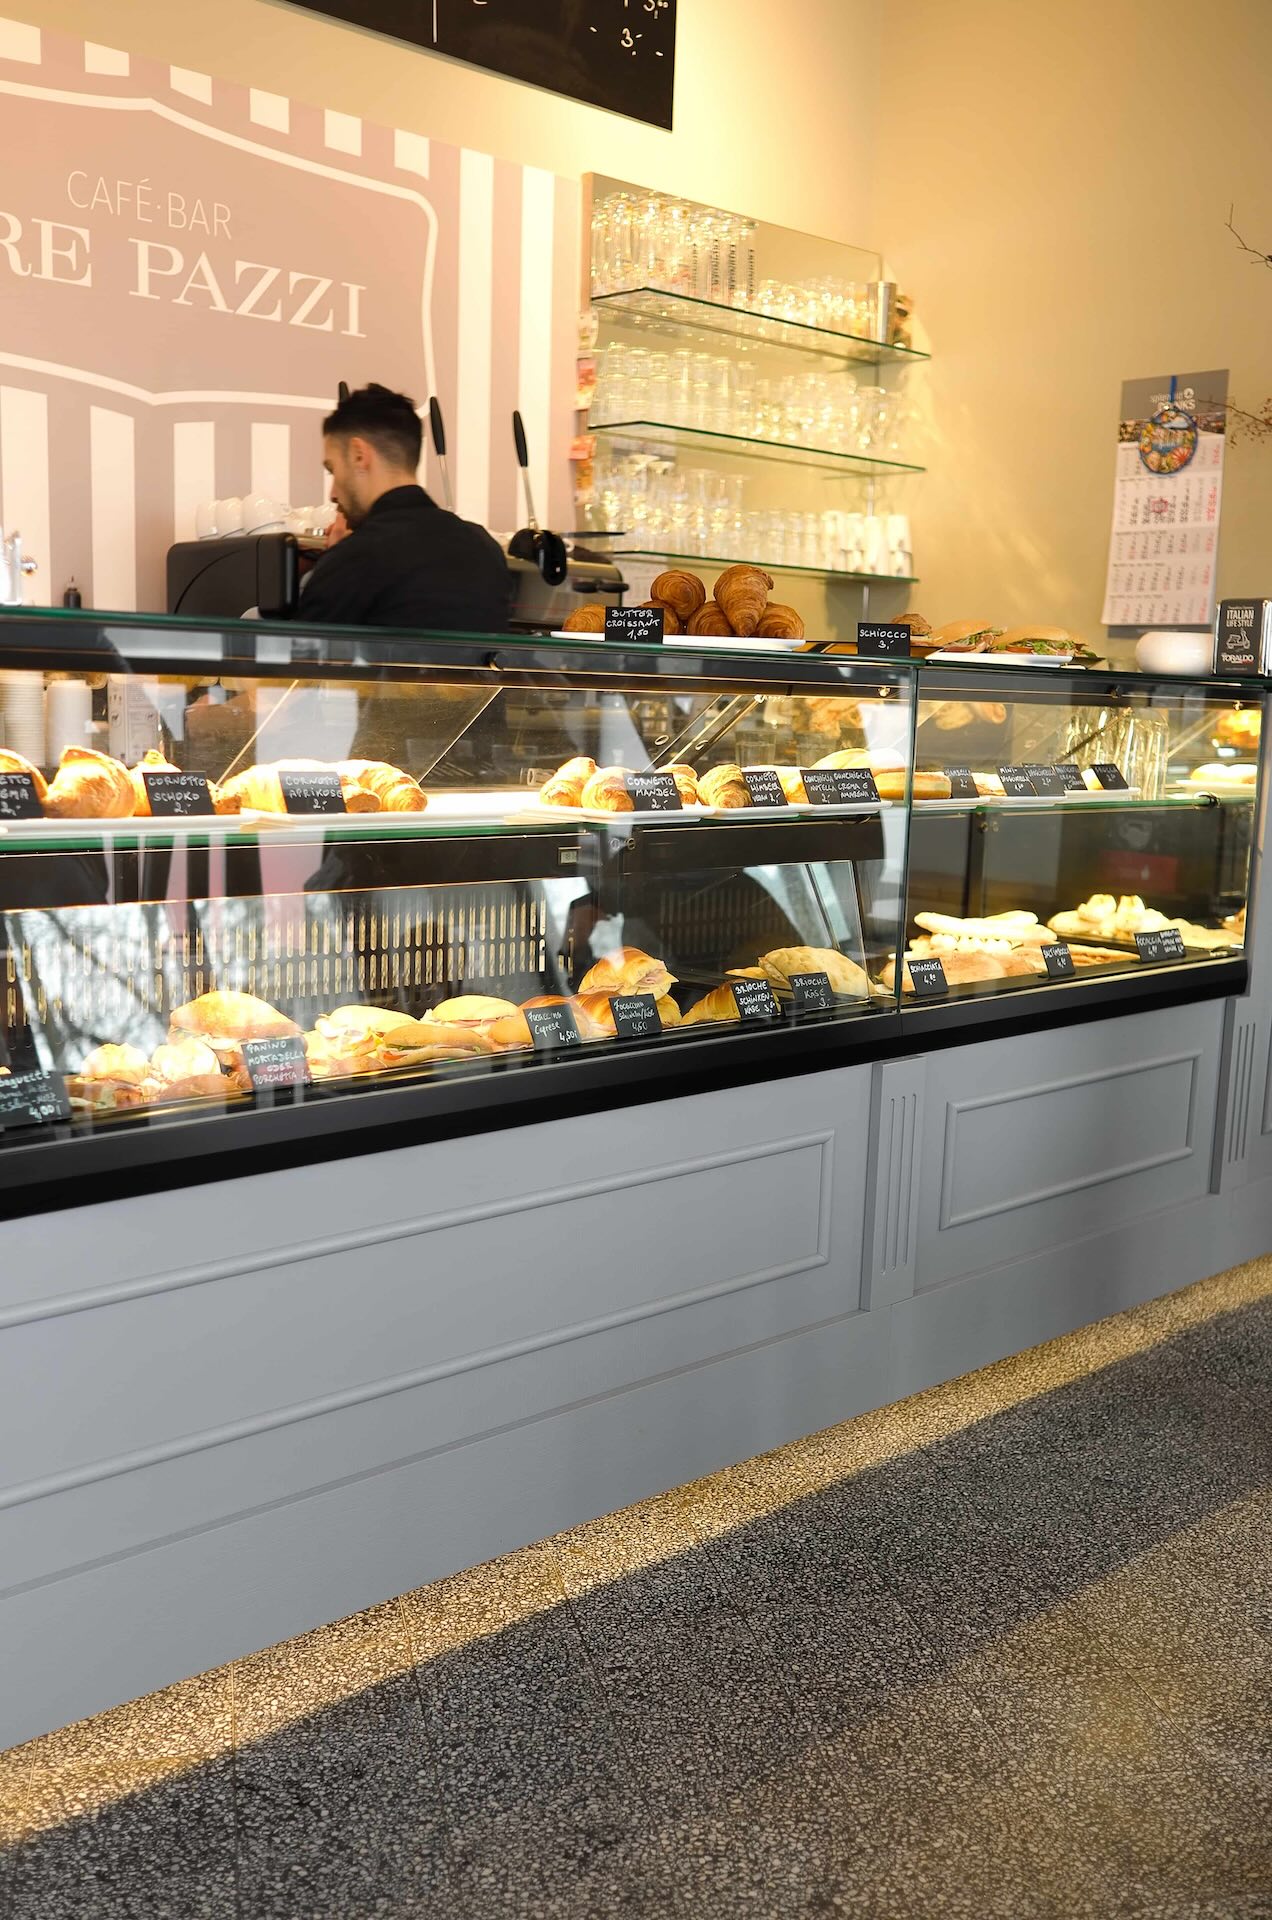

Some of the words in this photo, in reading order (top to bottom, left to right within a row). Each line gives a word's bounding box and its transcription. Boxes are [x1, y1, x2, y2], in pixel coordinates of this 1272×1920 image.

[128, 237, 367, 339] PAZZI
[611, 609, 654, 618] BUTTER
[1226, 609, 1255, 620] ITALIAN
[606, 618, 660, 628] CROISSANT
[626, 628, 649, 641] 1,50
[859, 628, 908, 639] SCHIOCCO
[148, 775, 206, 787] CORNETTO
[285, 775, 340, 786] CORNETTO
[626, 776, 674, 786] CORNETTO
[745, 771, 778, 784] CORNETTO
[153, 791, 200, 802] SCHOKO
[289, 786, 344, 799] APRIKOSE
[635, 787, 676, 797] MANDEL
[735, 981, 768, 994] BRIOCHE
[794, 977, 828, 987] BRIOCHE
[246, 1040, 287, 1053] PANINO
[248, 1050, 305, 1066] MORTADELLA
